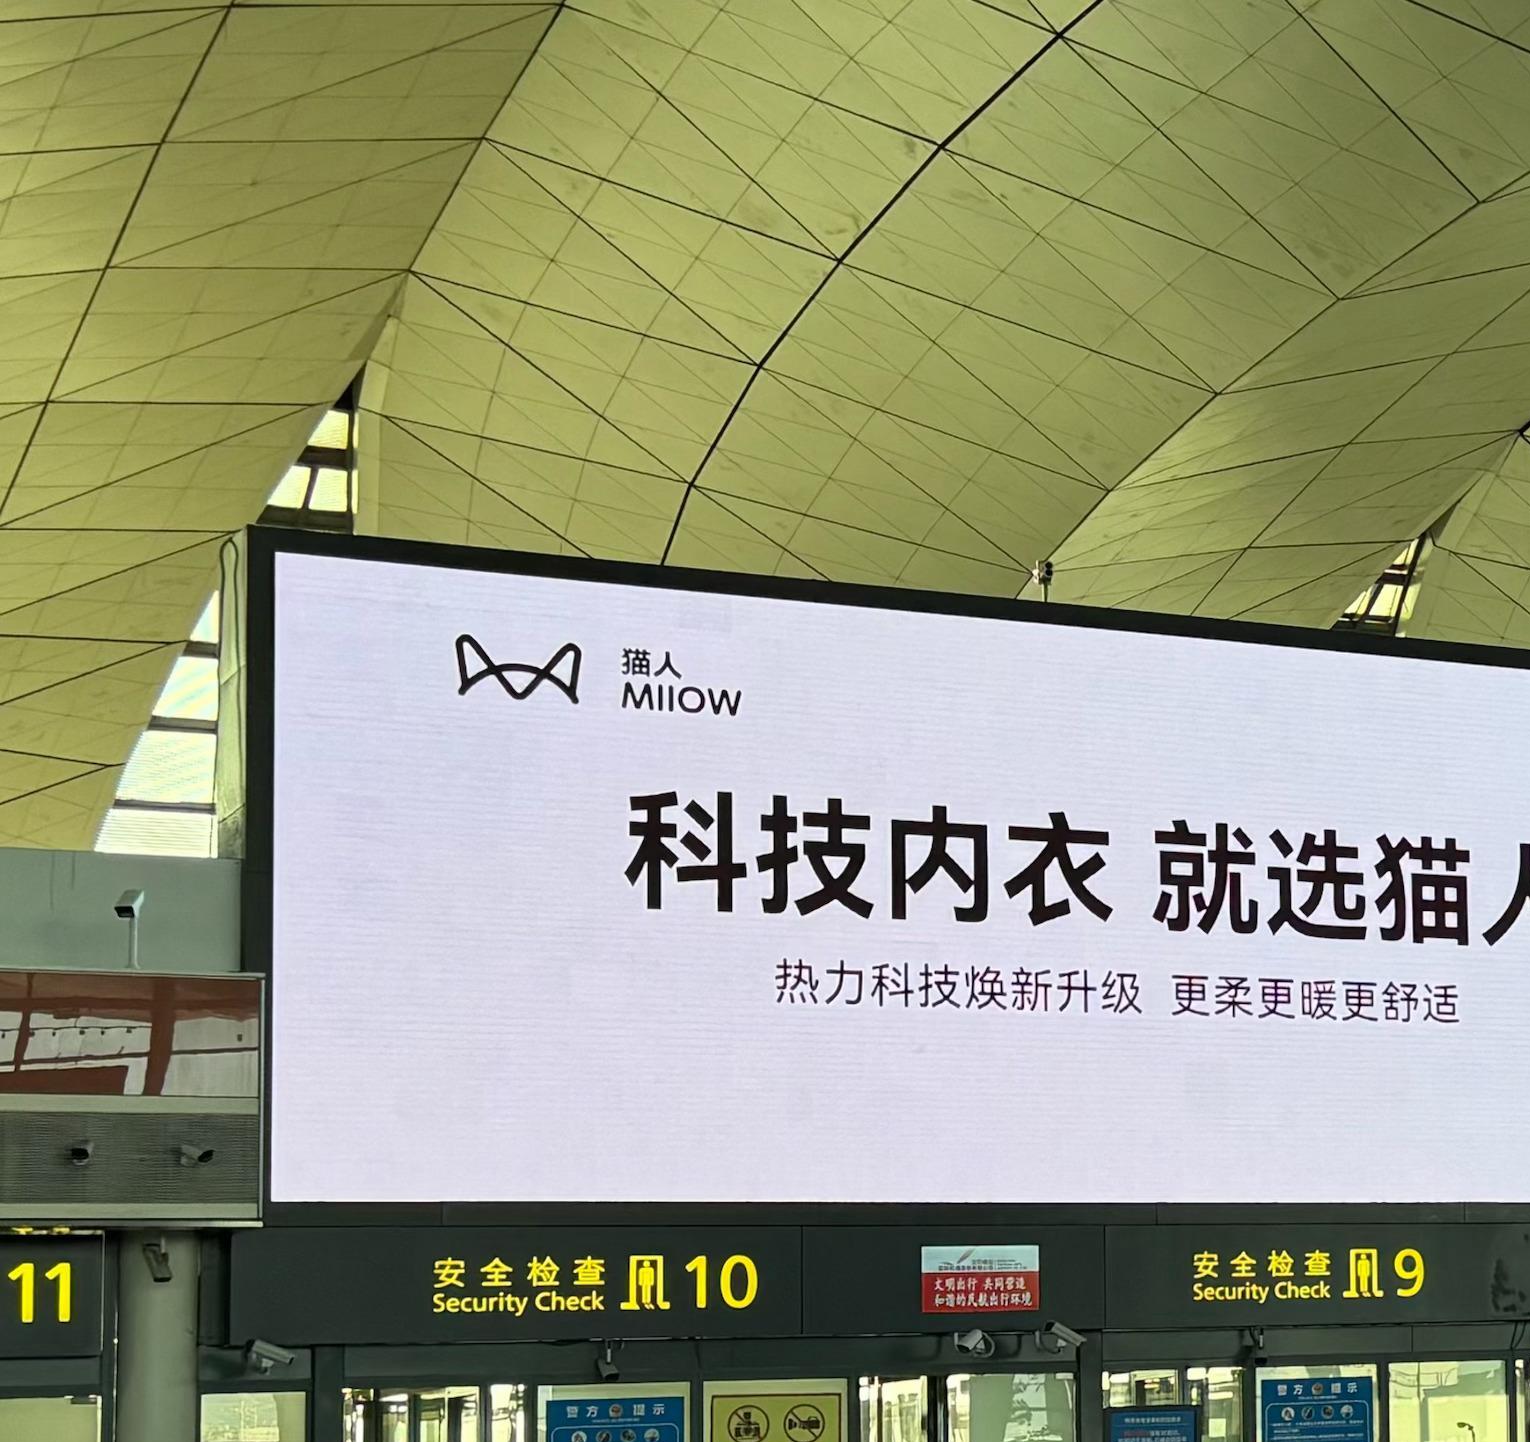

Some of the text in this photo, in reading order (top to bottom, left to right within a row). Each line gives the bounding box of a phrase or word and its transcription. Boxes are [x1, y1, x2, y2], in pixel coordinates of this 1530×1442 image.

[621, 646, 684, 681] 猫人
[621, 684, 742, 717] MIIOW
[624, 790, 1113, 926] 科技内衣
[774, 958, 1461, 1025] 热力科技焕新升级 更柔更暖更舒适
[7, 1261, 72, 1324] 11
[432, 1253, 760, 1310] 安全检查 10
[1192, 1247, 1426, 1298] 安全检查 9
[1192, 1280, 1331, 1304] Security Check
[432, 1290, 605, 1317] Security Check
